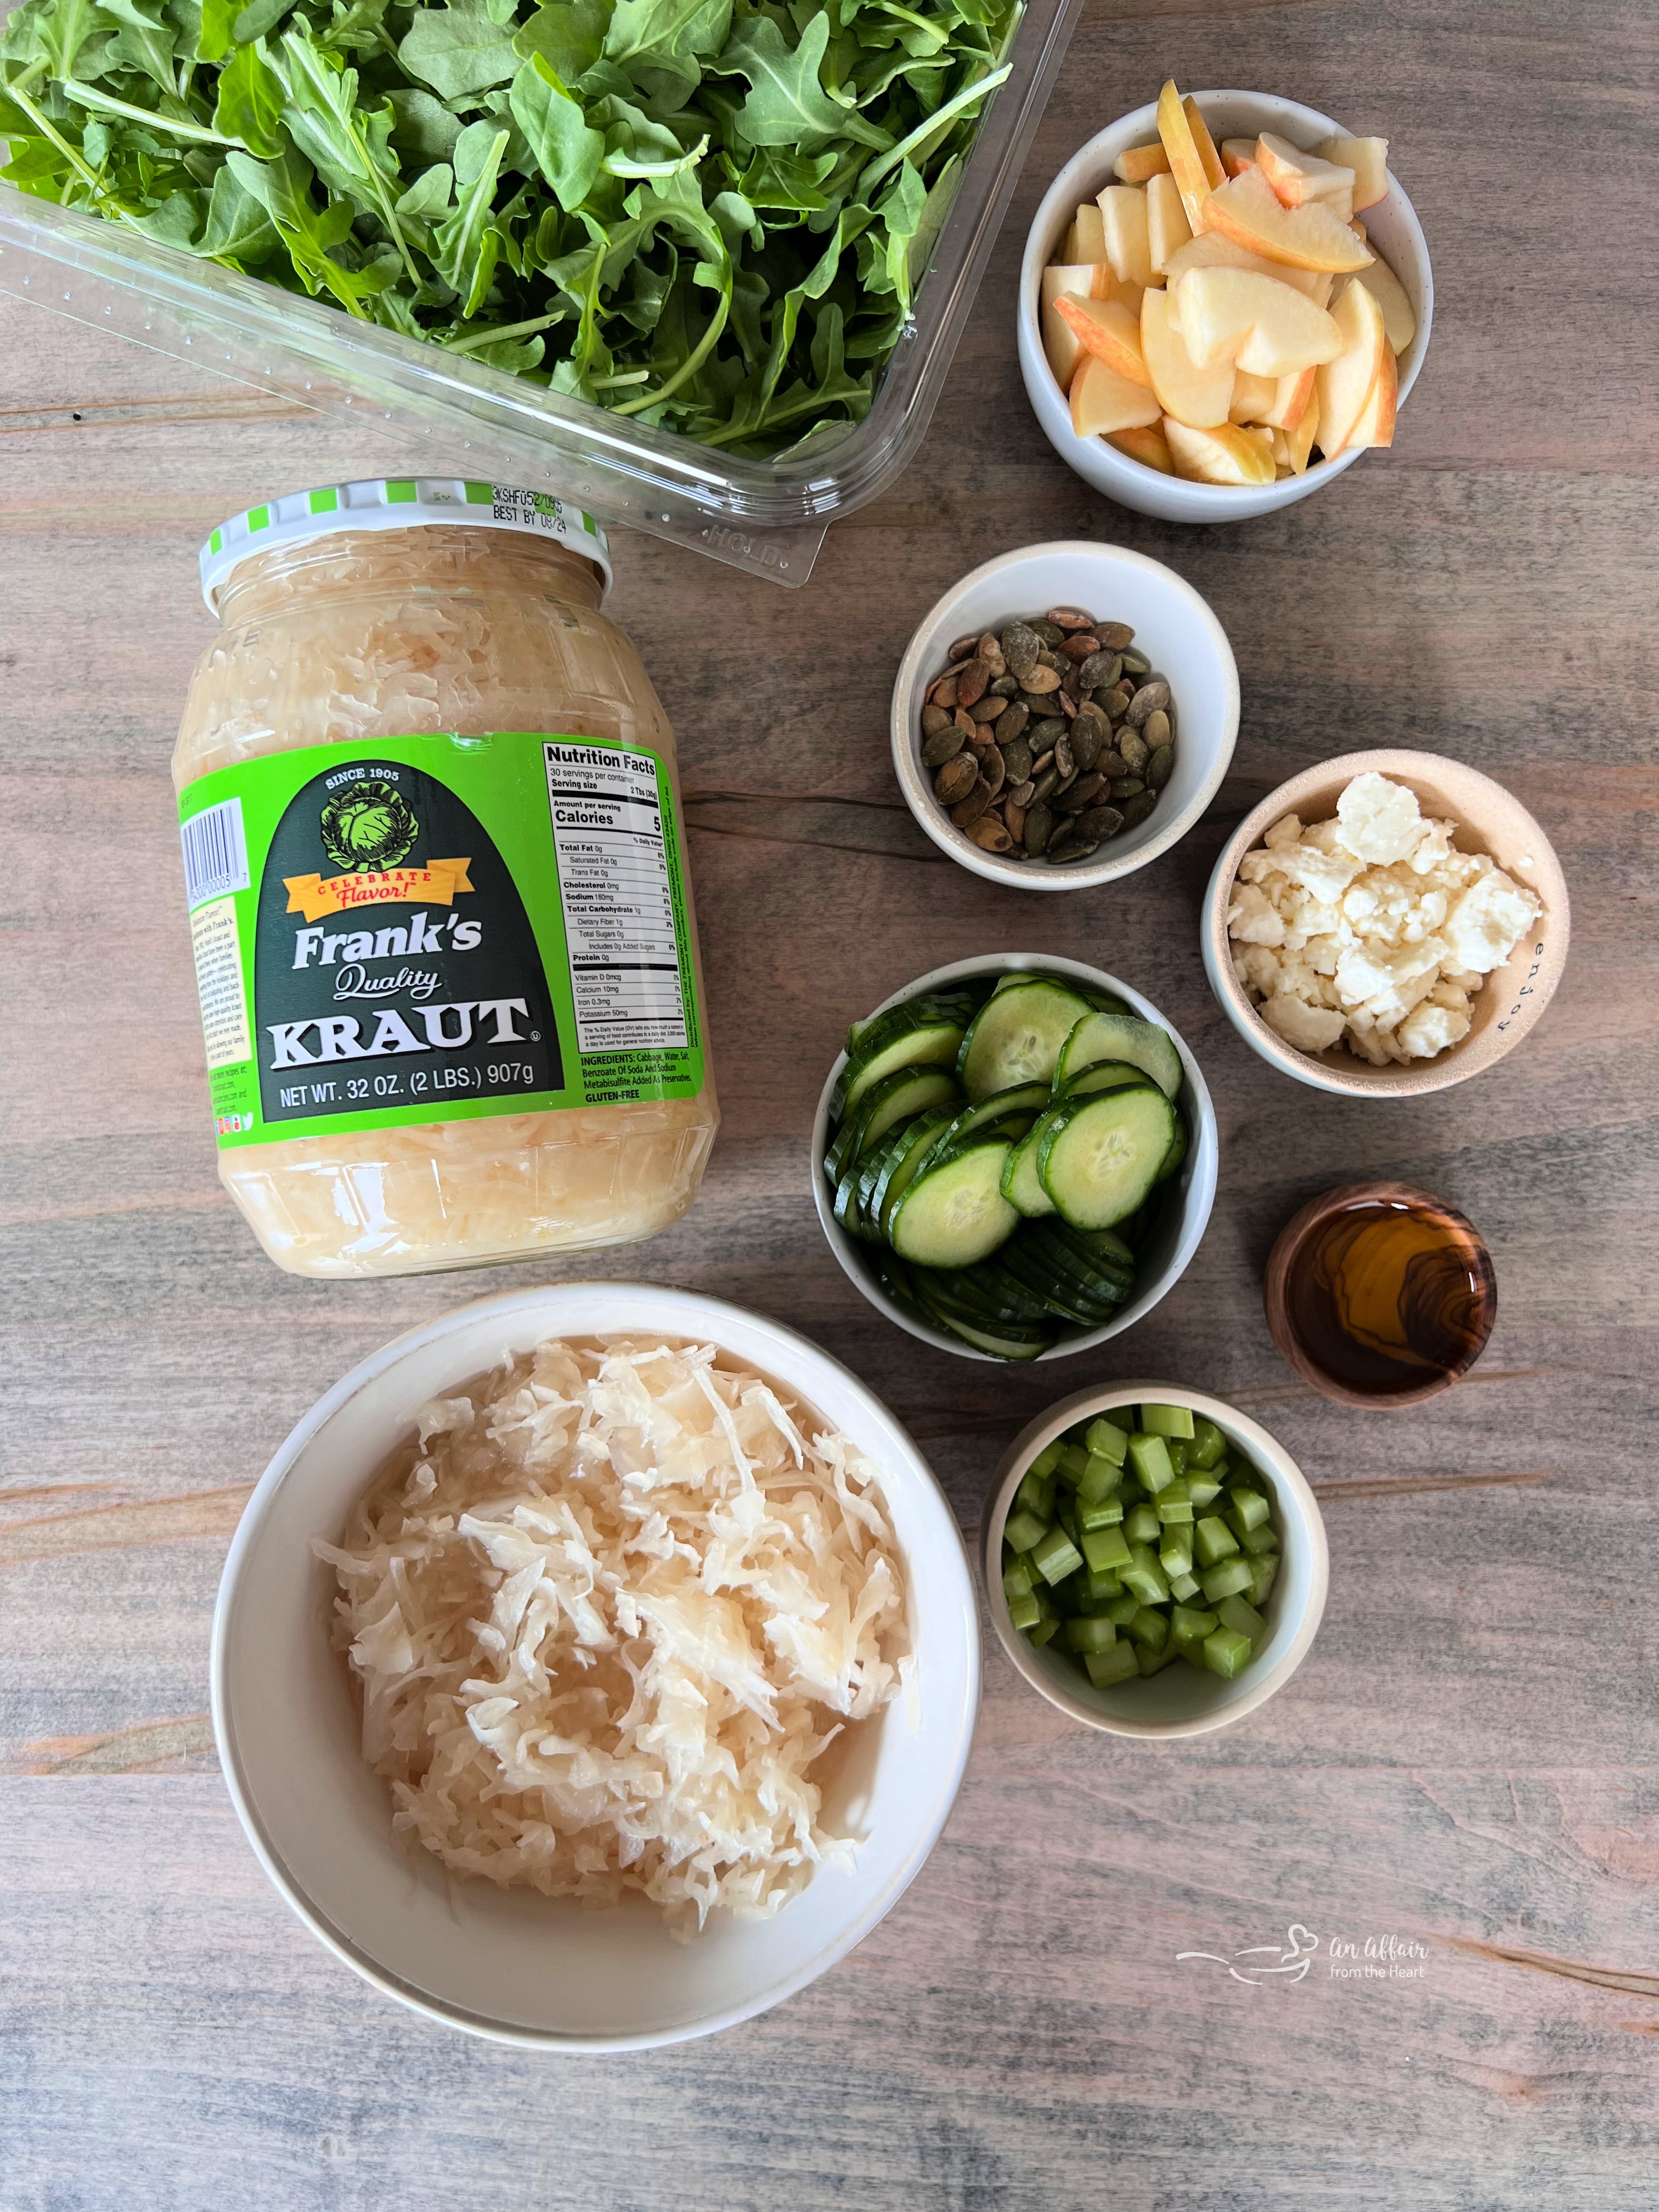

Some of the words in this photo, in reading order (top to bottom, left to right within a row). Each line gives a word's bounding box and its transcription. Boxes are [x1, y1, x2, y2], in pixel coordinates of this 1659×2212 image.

[494, 505, 517, 522] BEST
[523, 510, 535, 524] BY
[541, 512, 566, 534] 08/24
[707, 524, 782, 568] HOLD
[547, 747, 620, 768] Nutrition
[623, 754, 655, 775] Facts
[325, 768, 365, 790] SINCE
[370, 768, 399, 781] 1905
[563, 769, 593, 780] servings
[608, 774, 634, 783] container
[552, 779, 581, 789] Serving
[584, 781, 597, 789] size
[646, 789, 657, 800] (30g)
[556, 810, 613, 825] Calories
[654, 816, 661, 831] 5
[243, 873, 246, 882] 7
[318, 872, 431, 895] CELEBRATE
[292, 911, 482, 969] Frank's
[333, 963, 442, 1001] Quality
[1497, 943, 1544, 1031] enjoy
[266, 998, 529, 1070] KRAUT
[581, 1054, 635, 1066] INGREDIENTS:
[637, 1053, 663, 1063] Cabbage,
[664, 1052, 680, 1061] Water,
[583, 1069, 616, 1077] Benzoate
[618, 1065, 626, 1074] Of
[628, 1065, 643, 1074] Soda
[584, 1077, 630, 1089] Metabisulfite
[633, 1076, 652, 1085] Added
[662, 1074, 691, 1083] Preservatives.
[280, 1086, 307, 1108] NET
[311, 1082, 342, 1104] WT.
[347, 1079, 369, 1099] 32
[374, 1075, 404, 1097] OZ.
[410, 1071, 427, 1096] (2
[434, 1067, 481, 1090] LBS.)
[487, 1063, 533, 1084] 907g
[586, 1090, 640, 1102] GLUTEN-FREE
